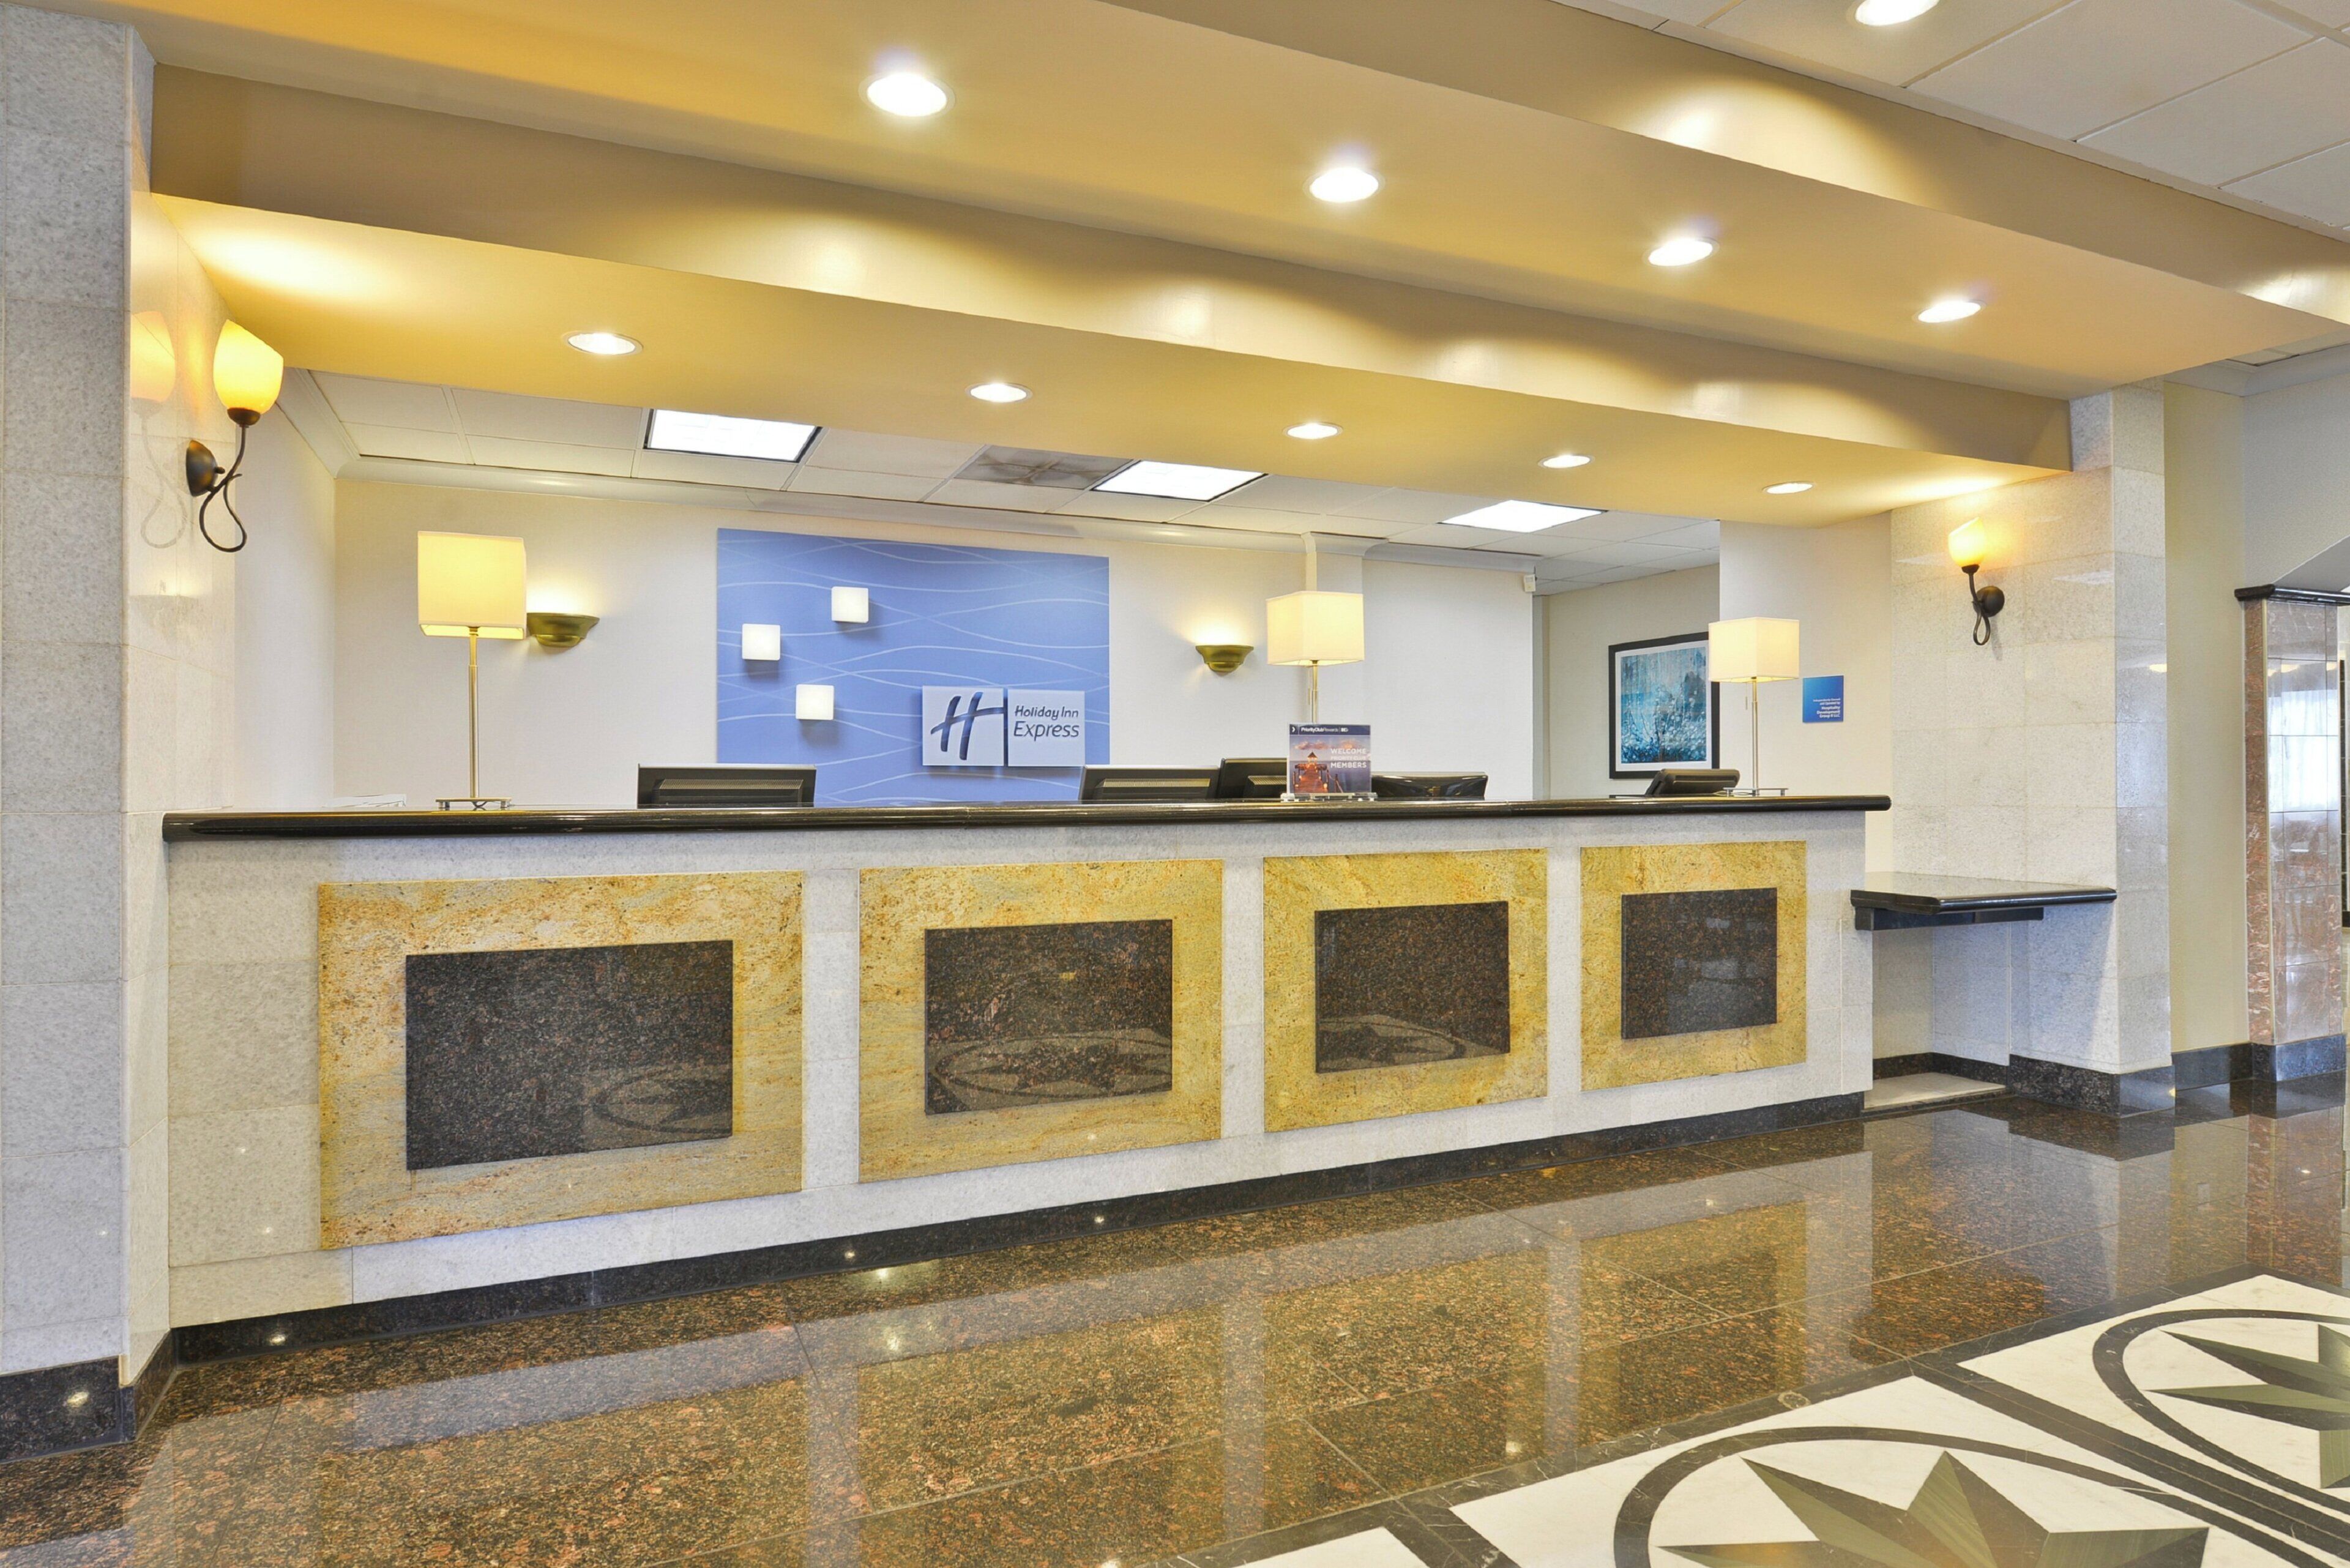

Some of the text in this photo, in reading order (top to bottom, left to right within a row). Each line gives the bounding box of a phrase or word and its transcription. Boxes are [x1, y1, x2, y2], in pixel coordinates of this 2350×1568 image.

[1014, 705, 1079, 720] Holiday Inn
[1013, 720, 1080, 742] Express
